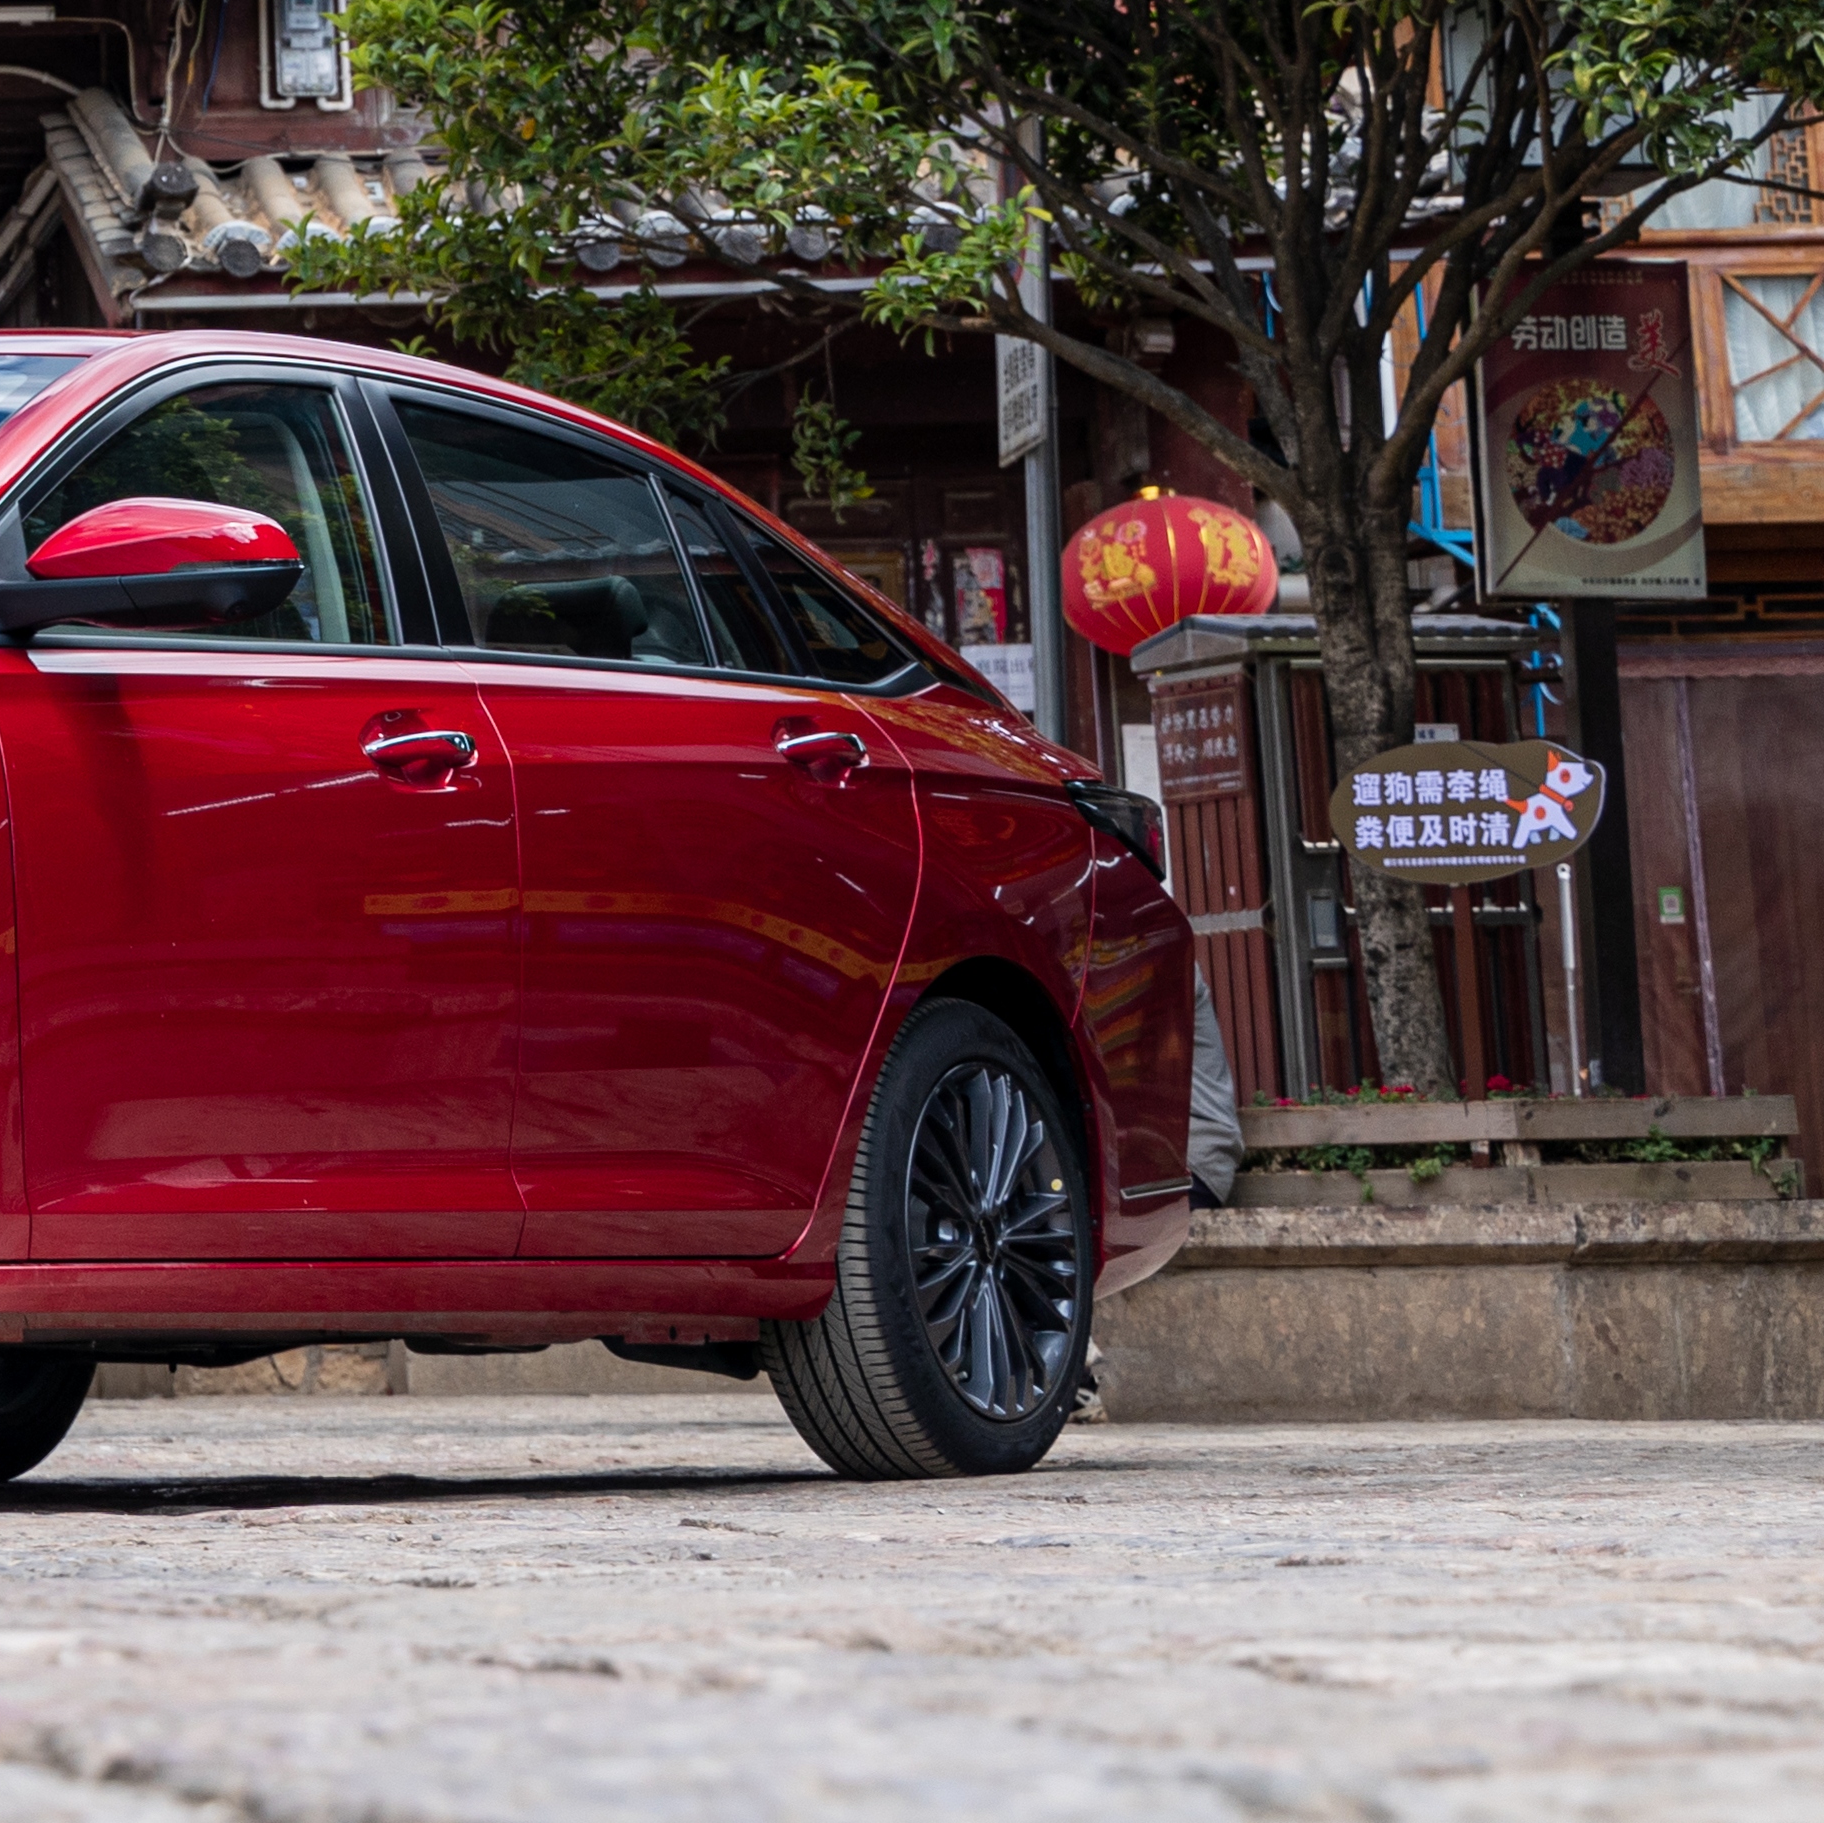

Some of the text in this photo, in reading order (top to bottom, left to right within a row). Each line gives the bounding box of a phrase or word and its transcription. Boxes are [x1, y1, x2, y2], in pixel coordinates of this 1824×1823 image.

[1352, 769, 1509, 807] 遛狗需牵绳
[1354, 811, 1511, 850] 粪便及时清
